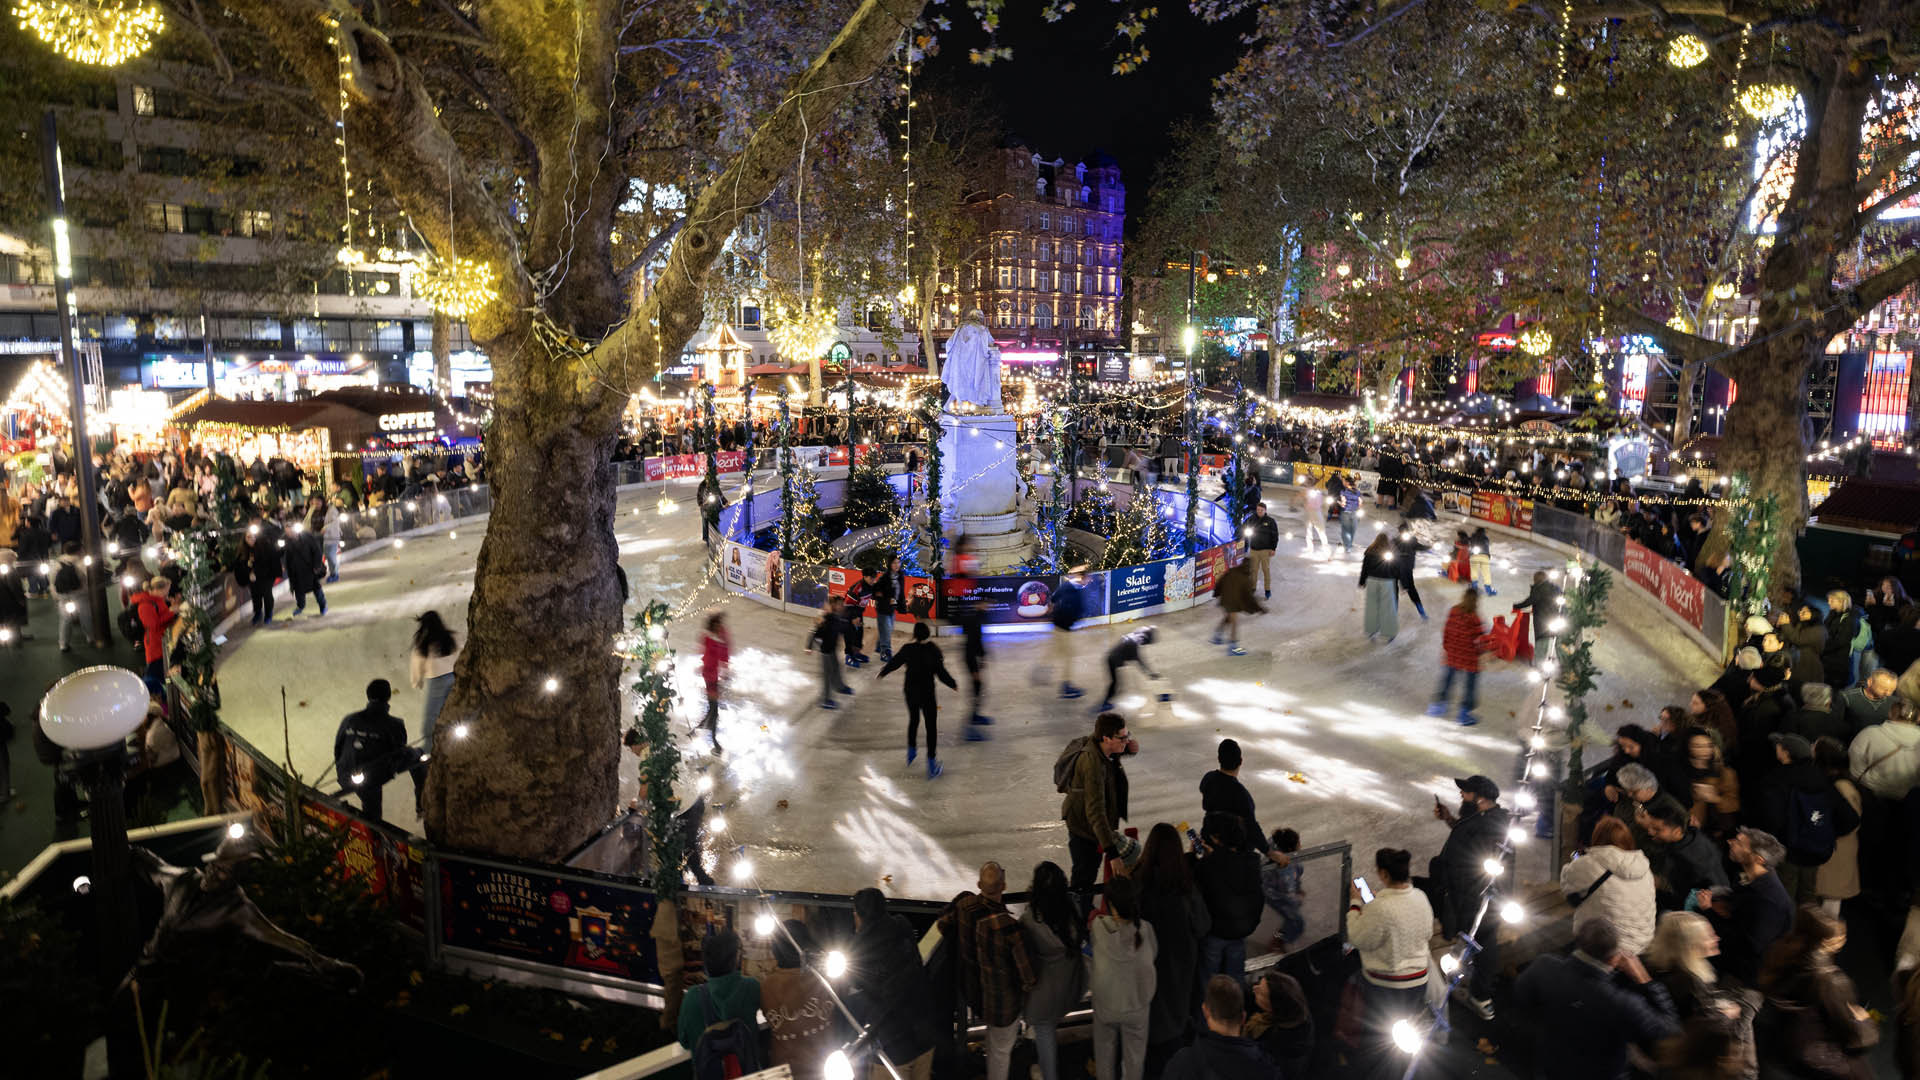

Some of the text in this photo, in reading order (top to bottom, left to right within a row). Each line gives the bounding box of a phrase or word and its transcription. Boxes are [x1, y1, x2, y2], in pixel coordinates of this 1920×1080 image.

[379, 411, 436, 431] COFFEE
[651, 463, 695, 477] CHRISTMAS
[1125, 574, 1151, 588] Skate
[1627, 560, 1659, 589] CHRISTMAS
[973, 587, 983, 595] gift
[1117, 583, 1159, 597] Leicester Square
[1670, 576, 1694, 613] heart
[490, 871, 532, 888] FATHER
[490, 894, 532, 911] GROTTO
